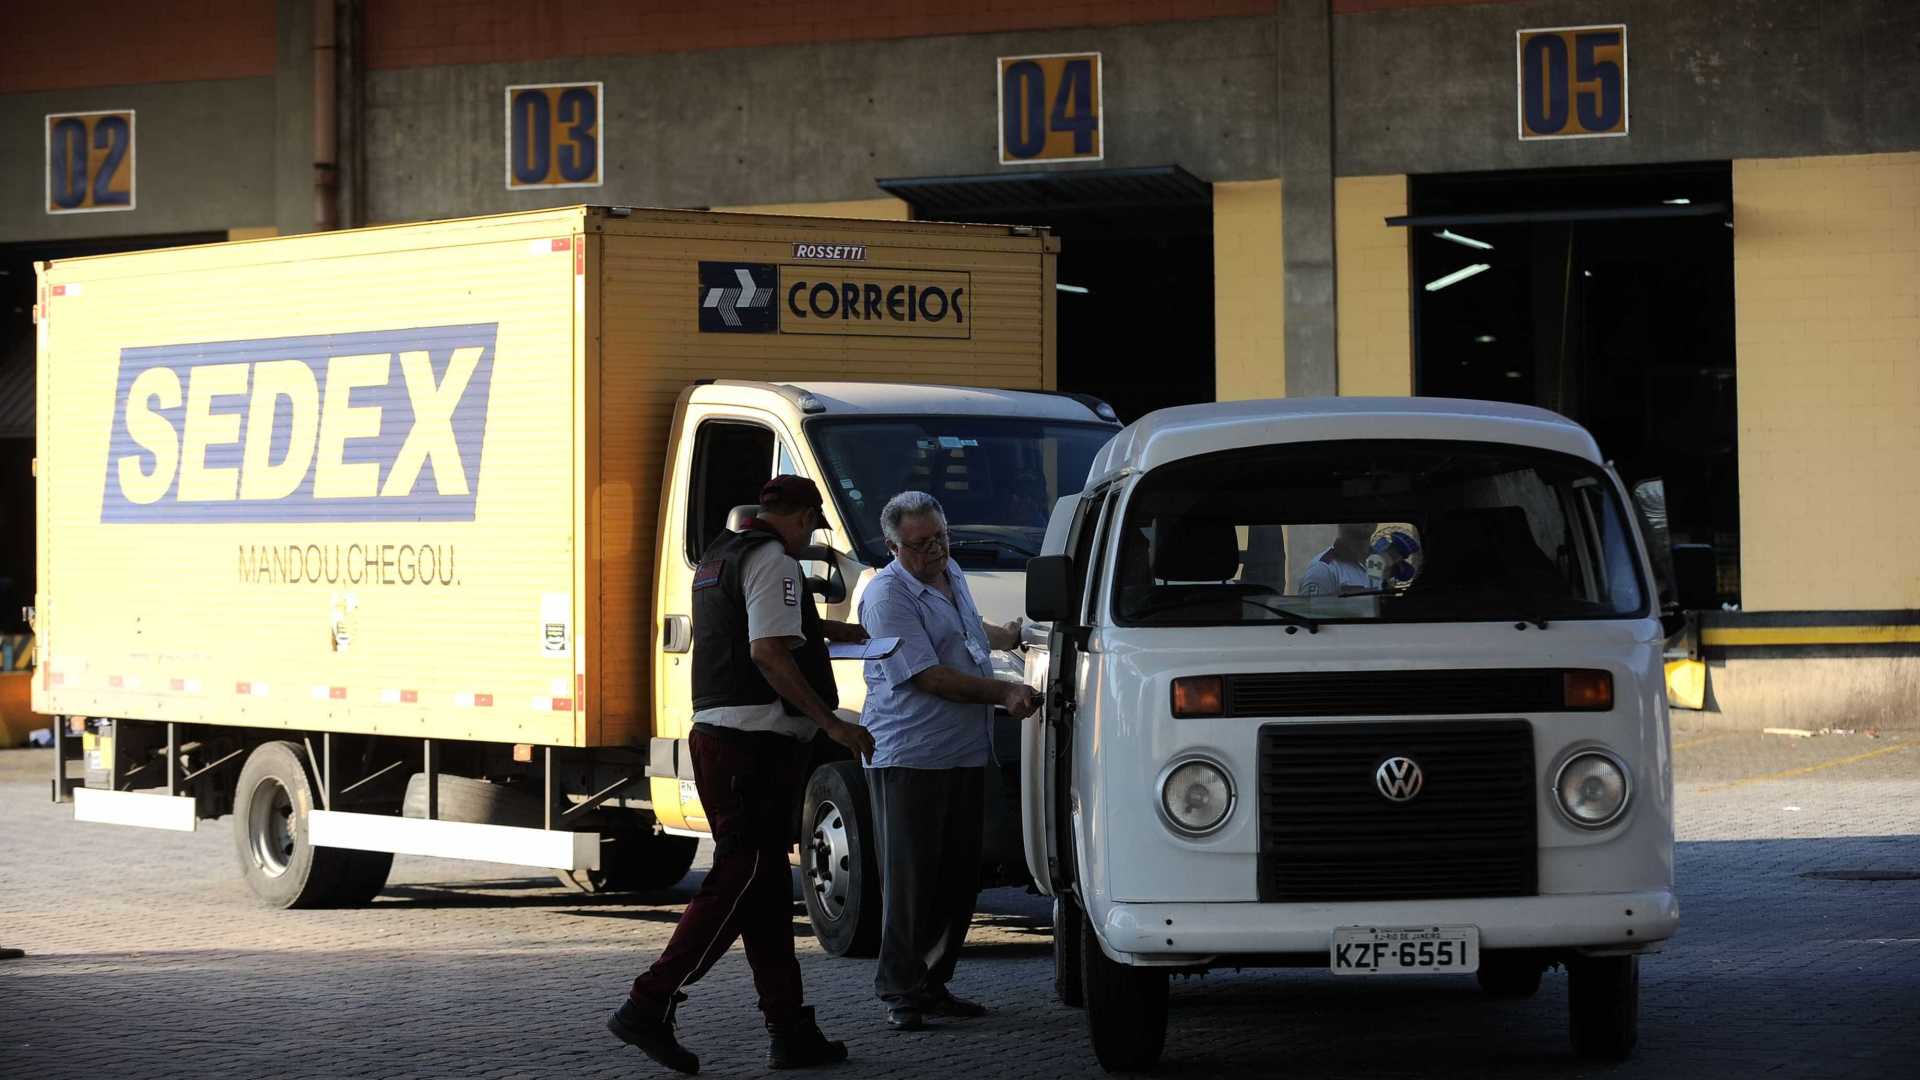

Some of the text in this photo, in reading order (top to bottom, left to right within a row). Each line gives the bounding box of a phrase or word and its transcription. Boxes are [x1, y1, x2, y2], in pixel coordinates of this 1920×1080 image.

[1006, 60, 1098, 158] 04
[1524, 32, 1621, 134] 05
[53, 116, 130, 208] 02
[513, 88, 596, 184] 03
[796, 244, 863, 260] ROSSETTI
[788, 281, 964, 323] CORREIOS
[118, 346, 485, 505] SEDEX
